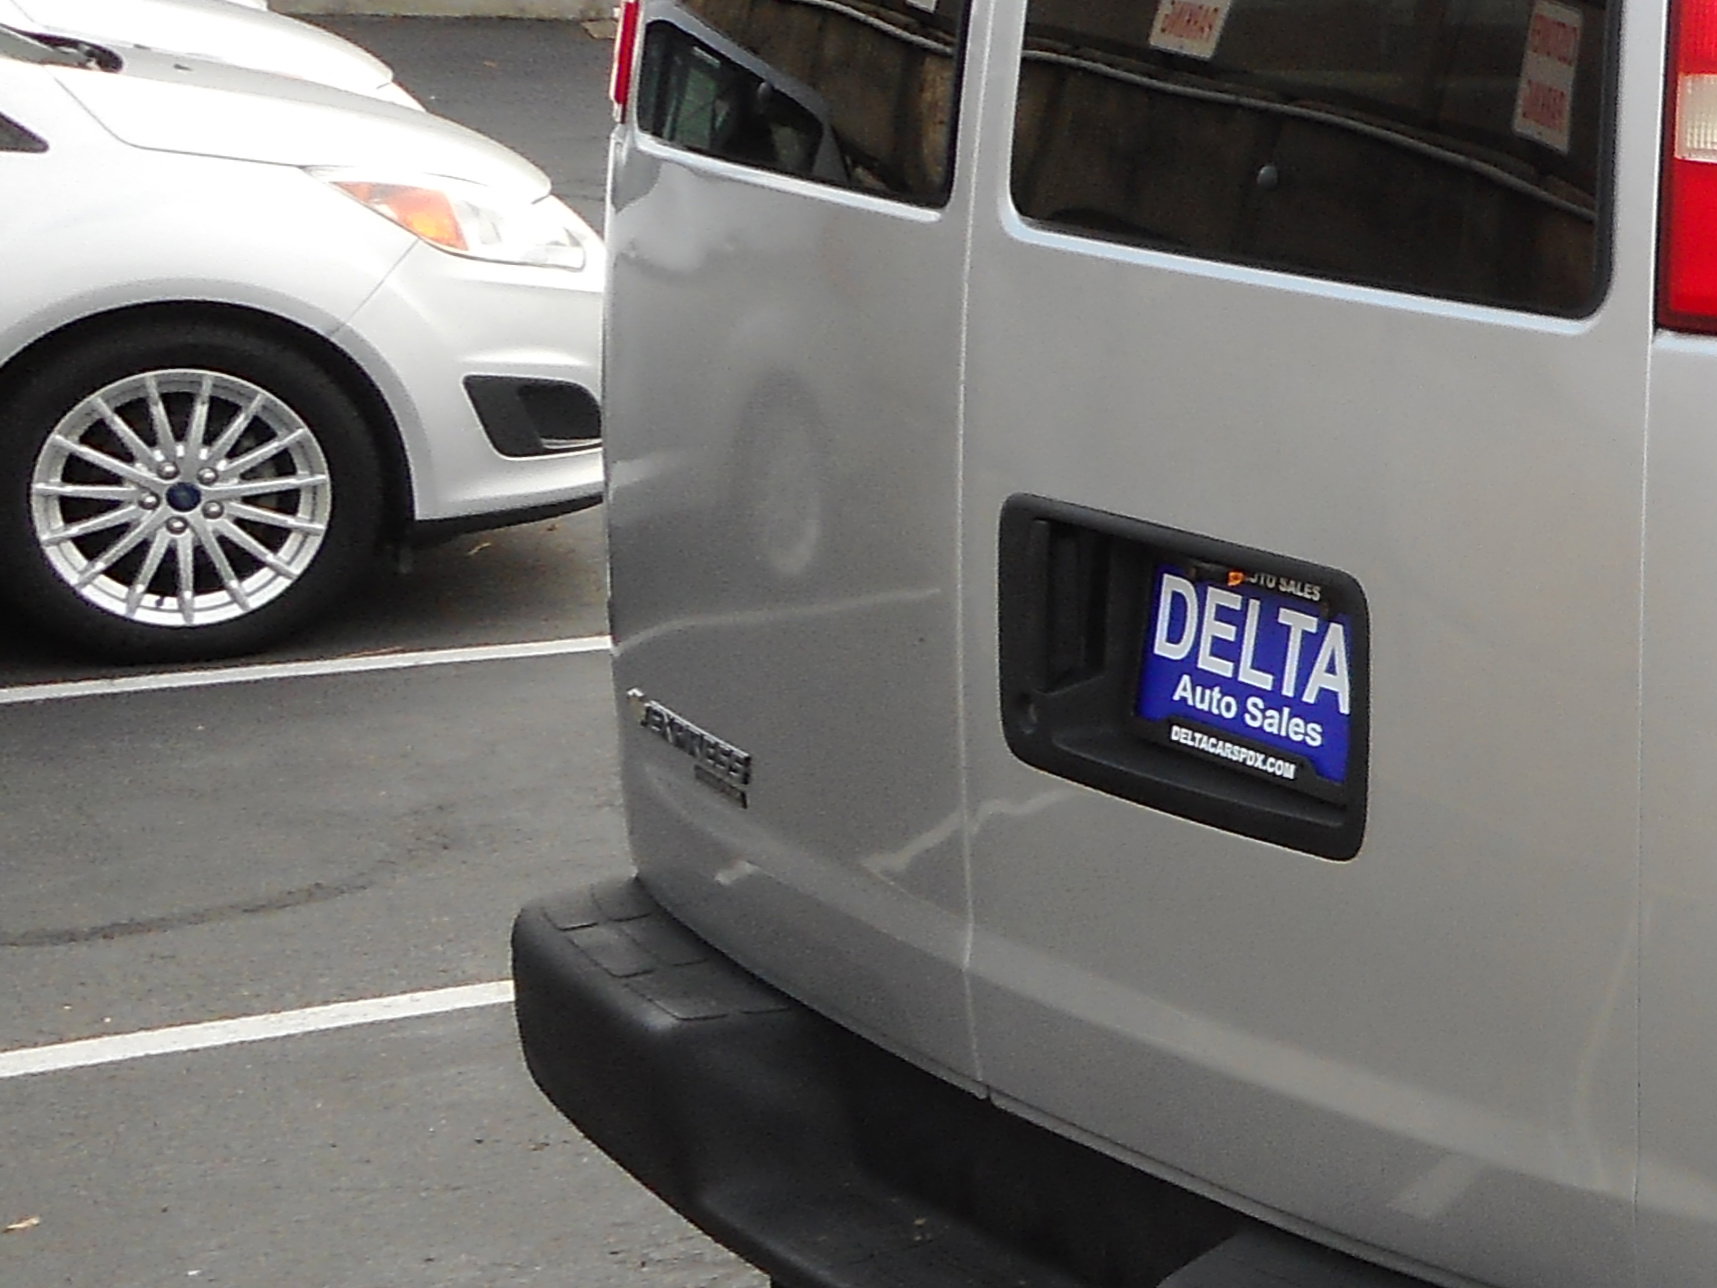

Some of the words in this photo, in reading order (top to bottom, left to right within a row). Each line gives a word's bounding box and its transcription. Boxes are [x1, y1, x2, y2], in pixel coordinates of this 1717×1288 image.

[1278, 577, 1322, 602] SALES
[1153, 572, 1351, 715] DELTA
[1172, 673, 1238, 719] Auto
[1244, 697, 1323, 747] Sales
[1170, 724, 1297, 780] DELTACARSPDX.COM
